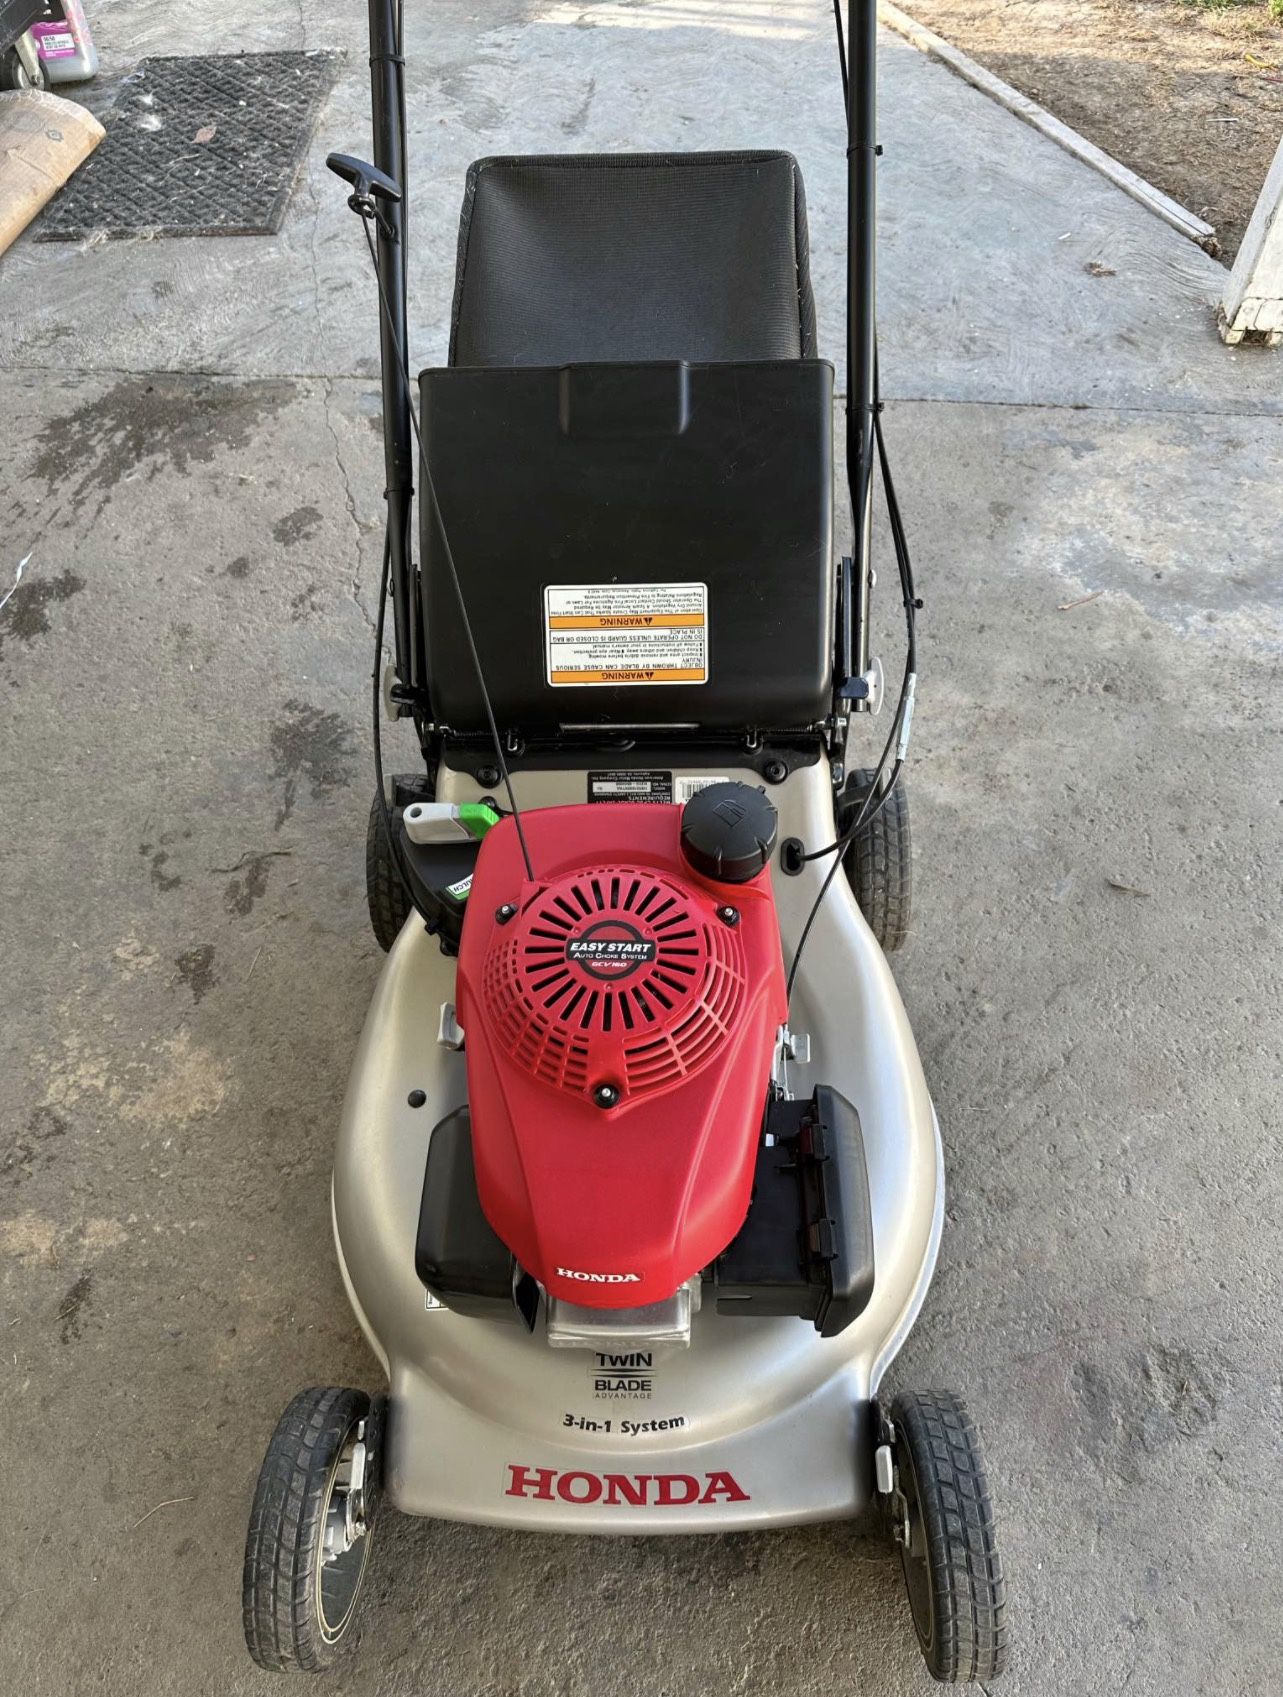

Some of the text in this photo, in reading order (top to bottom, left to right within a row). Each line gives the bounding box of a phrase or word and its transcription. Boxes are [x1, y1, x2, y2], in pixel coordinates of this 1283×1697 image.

[599, 617, 642, 625] WARNING
[601, 671, 644, 680] WARNING
[453, 878, 473, 893] ULCH
[570, 942, 651, 952] EASY START
[556, 1267, 641, 1283] HONDA
[596, 1352, 653, 1367] TWIN
[595, 1380, 652, 1392] BLADE
[563, 1414, 685, 1437] 3-in-1 System
[505, 1464, 751, 1505] HONDA
